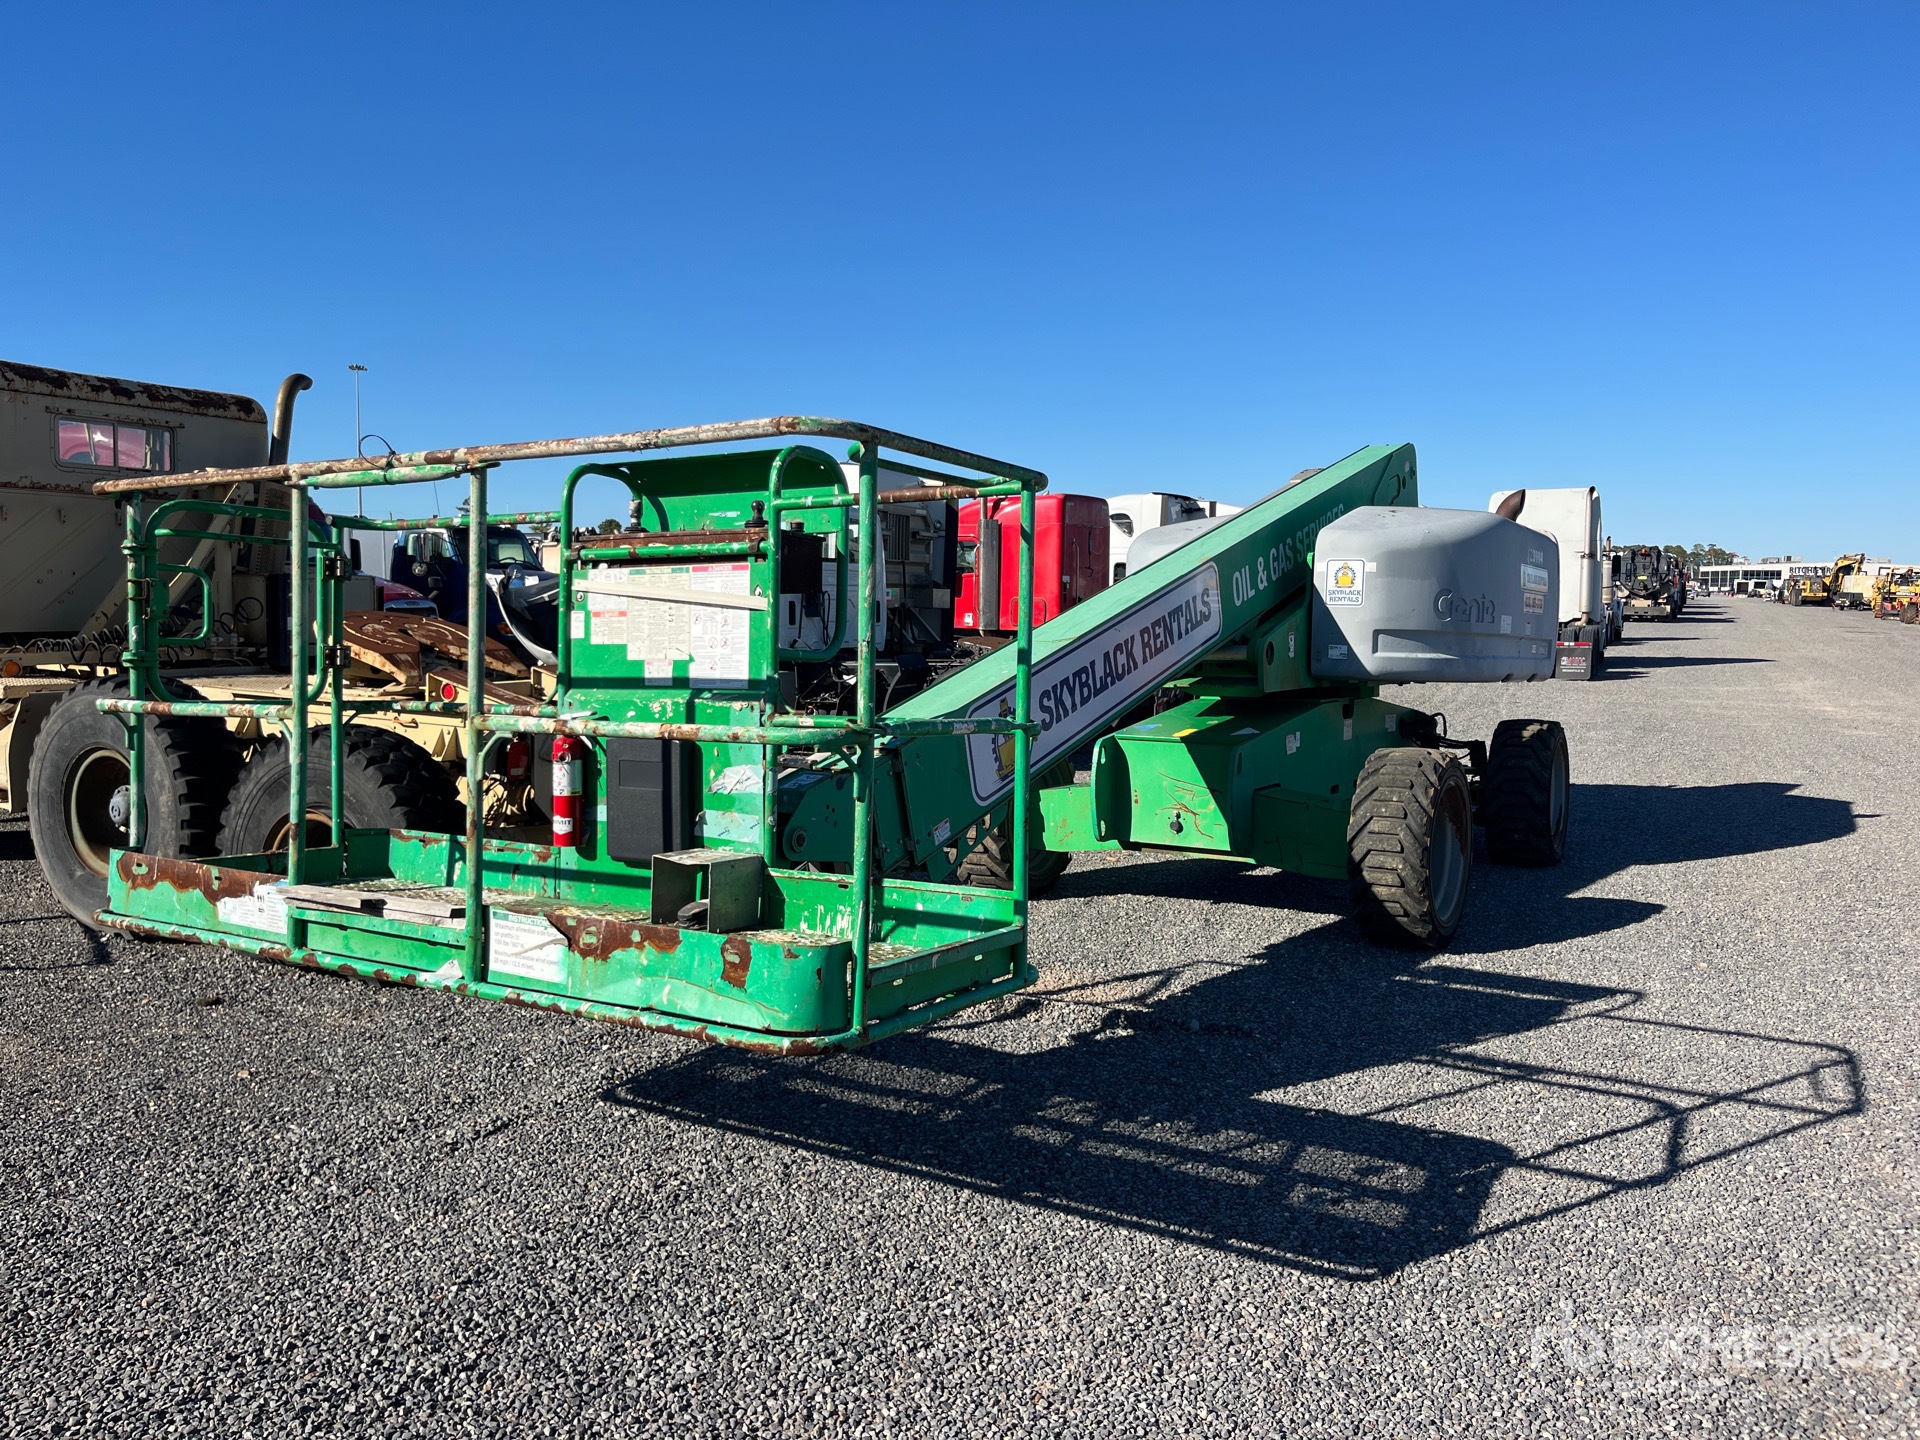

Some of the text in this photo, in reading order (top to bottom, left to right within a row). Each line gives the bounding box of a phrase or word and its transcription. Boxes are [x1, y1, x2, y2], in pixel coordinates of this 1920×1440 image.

[1232, 537, 1295, 607] OIL & GAS
[1328, 589, 1362, 597] SKYBLACK
[1433, 588, 1496, 624] Genie
[1038, 587, 1212, 732] SKYBLACK RENTALS
